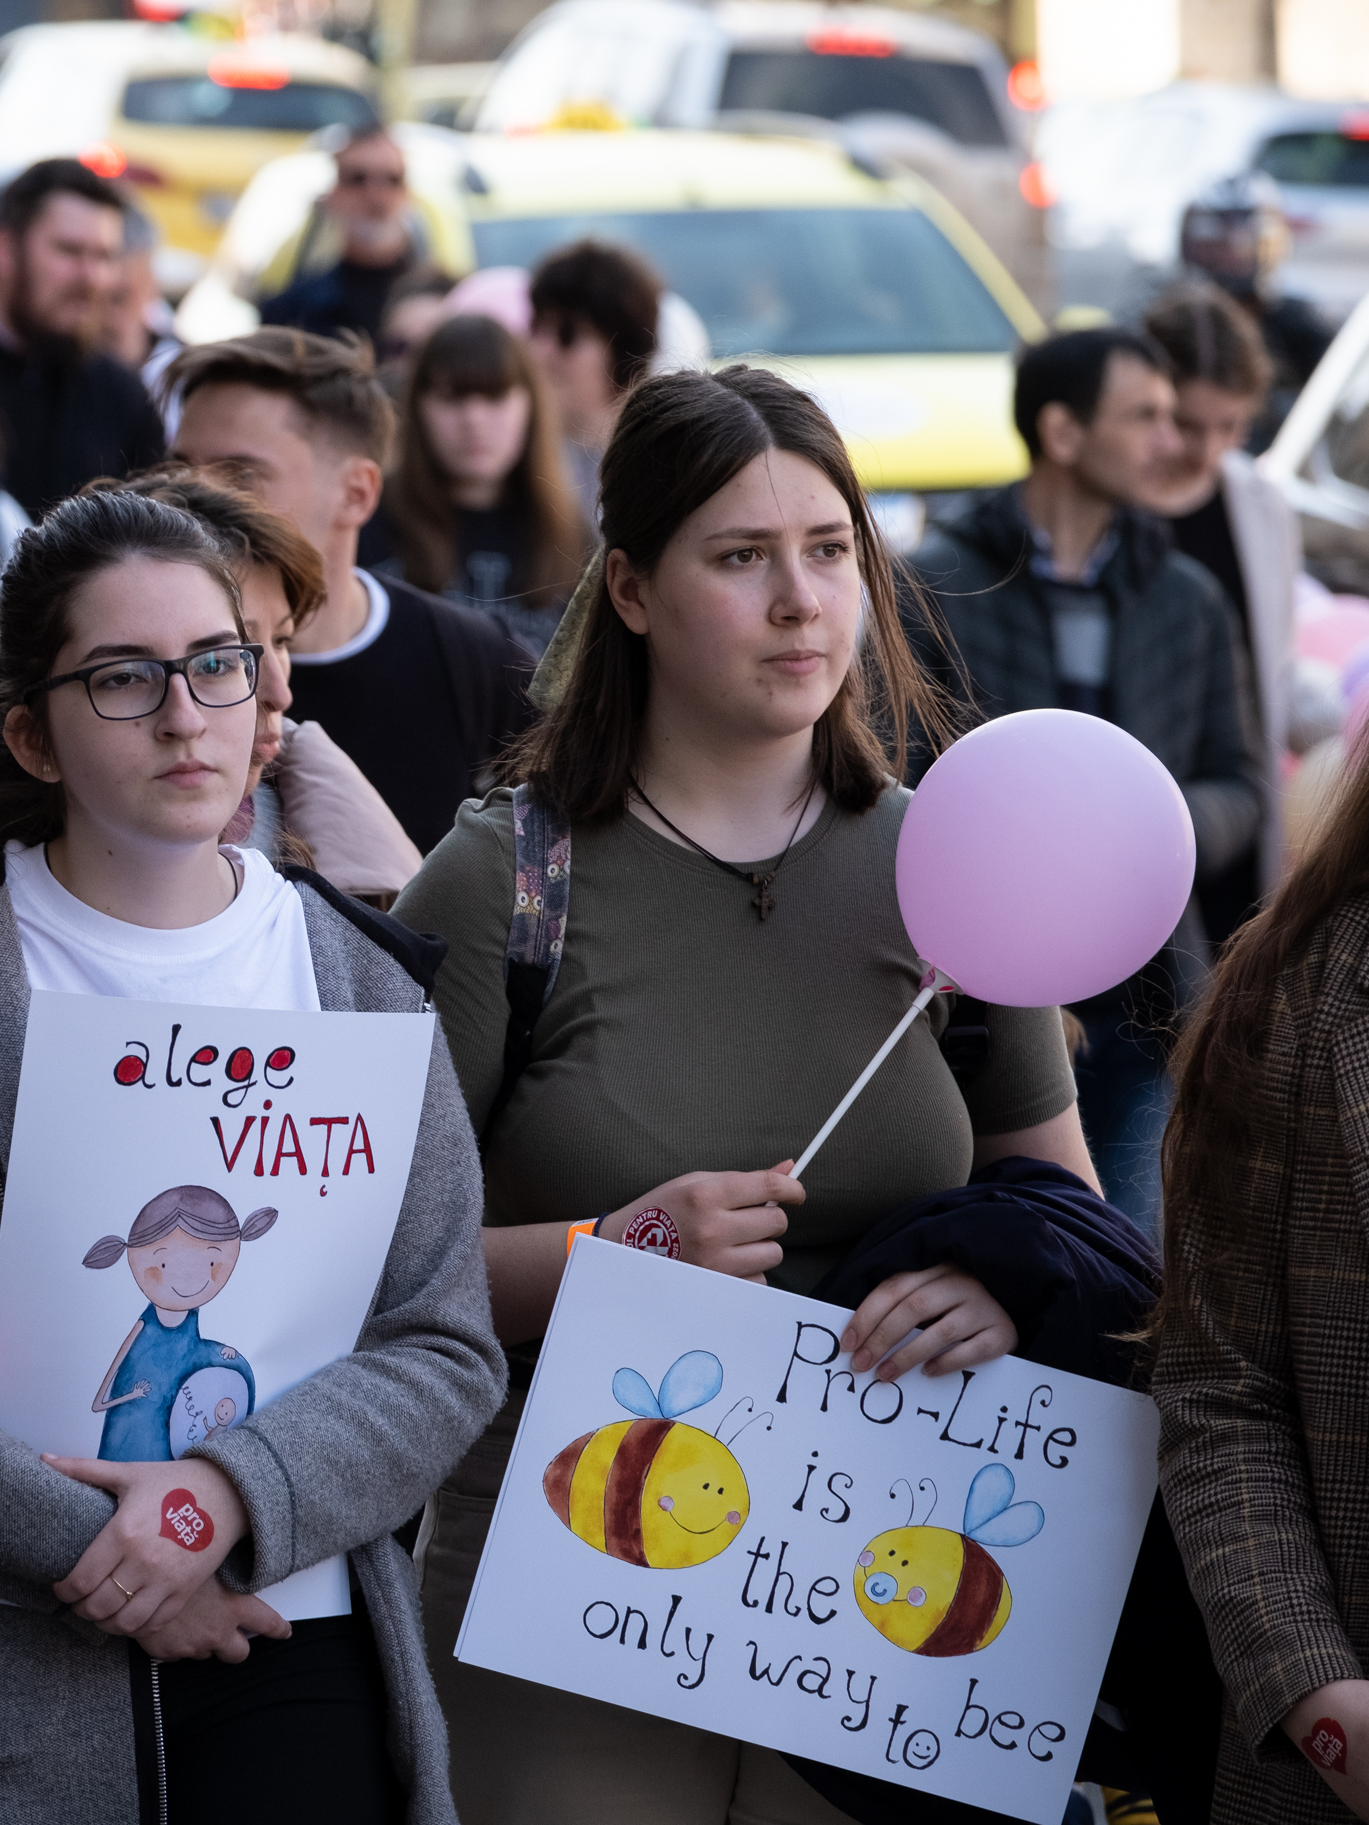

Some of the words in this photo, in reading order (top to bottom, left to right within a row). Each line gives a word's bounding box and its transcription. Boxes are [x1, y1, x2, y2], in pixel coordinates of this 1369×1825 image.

[113, 1023, 296, 1108] alege
[629, 1210, 658, 1235] PENTRU
[775, 1320, 1077, 1469] Pro-Life
[177, 1503, 204, 1531] pro
[792, 1450, 854, 1524] is
[739, 1535, 841, 1625] the
[582, 1594, 715, 1690] only
[746, 1640, 878, 1732] way
[885, 1704, 941, 1770] to
[955, 1678, 1067, 1762] bee
[1312, 1729, 1329, 1756] pro
